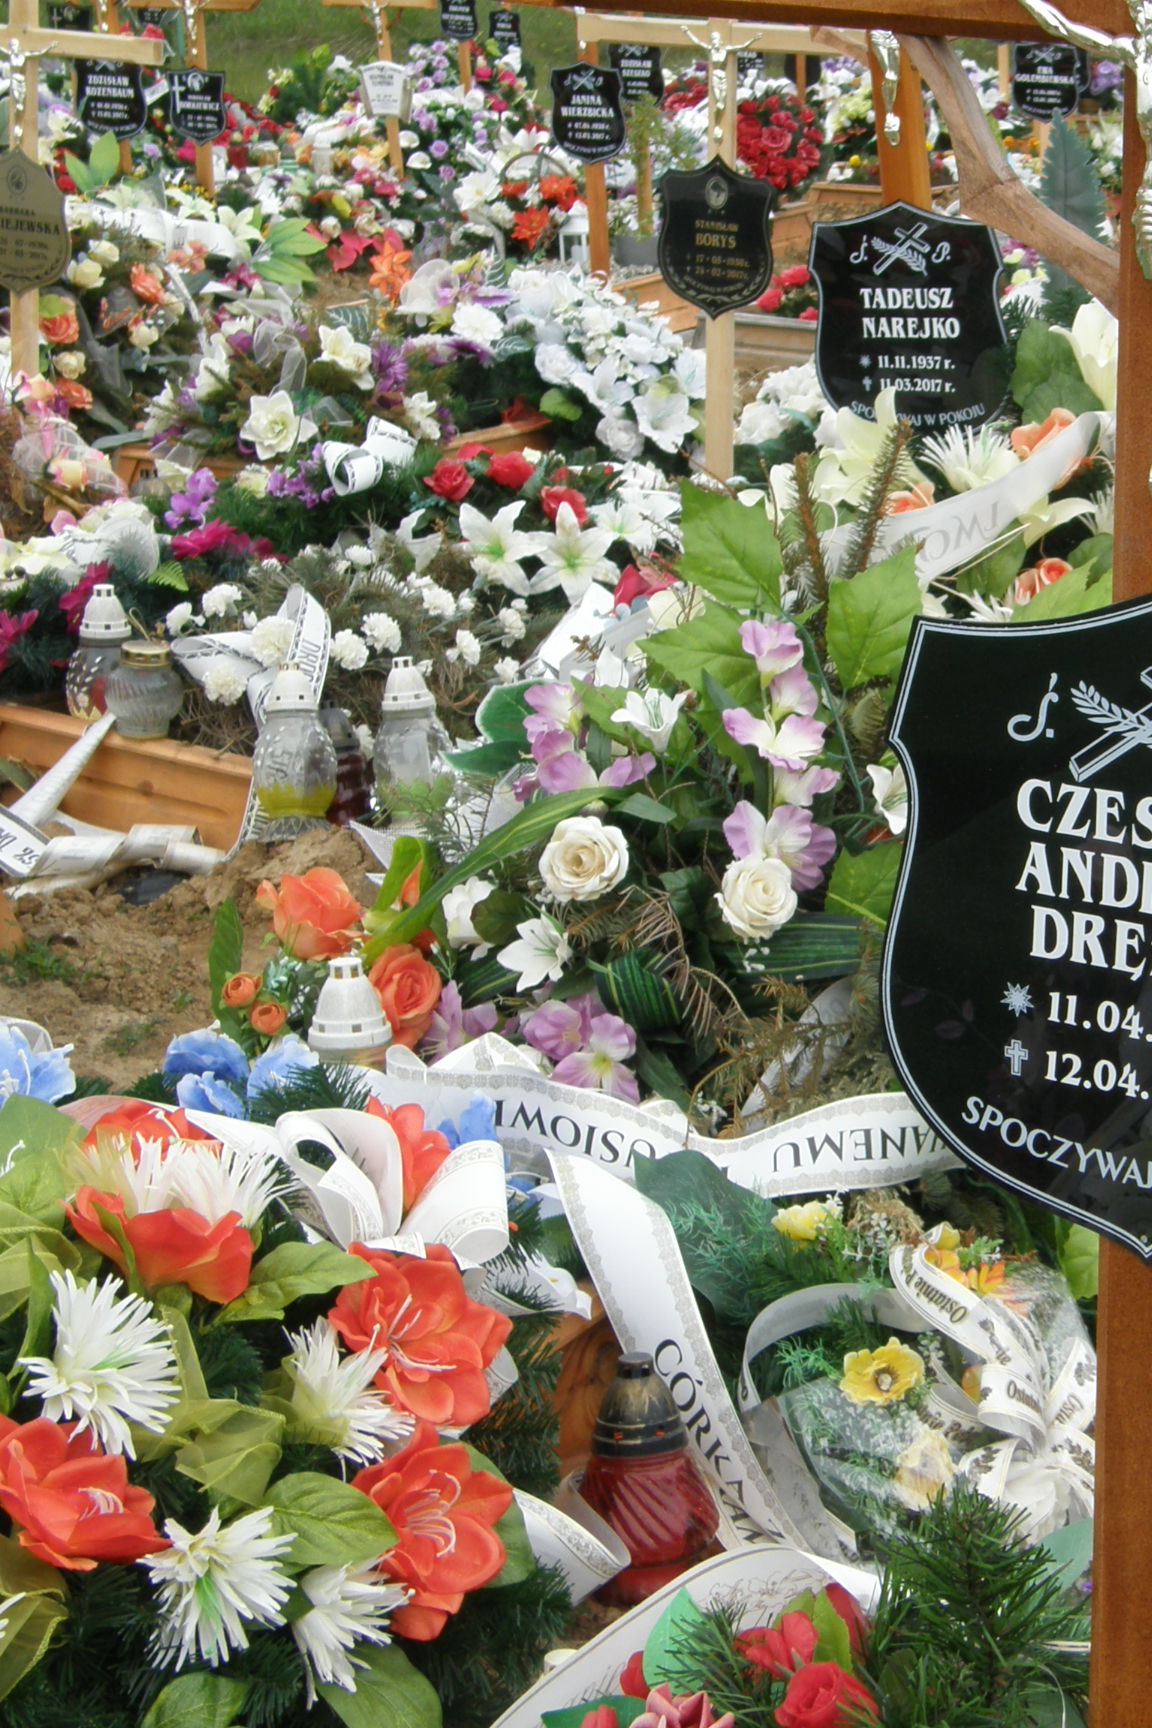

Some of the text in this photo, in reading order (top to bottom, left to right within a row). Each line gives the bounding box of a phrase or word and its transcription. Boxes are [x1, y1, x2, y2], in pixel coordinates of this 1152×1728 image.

[571, 94, 603, 105] JANINA
[560, 106, 615, 118] WIERZBICKA
[0, 218, 61, 236] IEJEWSKA
[695, 233, 737, 249] BORYS
[860, 287, 954, 310] TADEUSZ
[862, 316, 960, 339] NAREJKO
[878, 355, 941, 370] 11.11.1937
[924, 414, 938, 427] W
[939, 403, 986, 426] POKOJU
